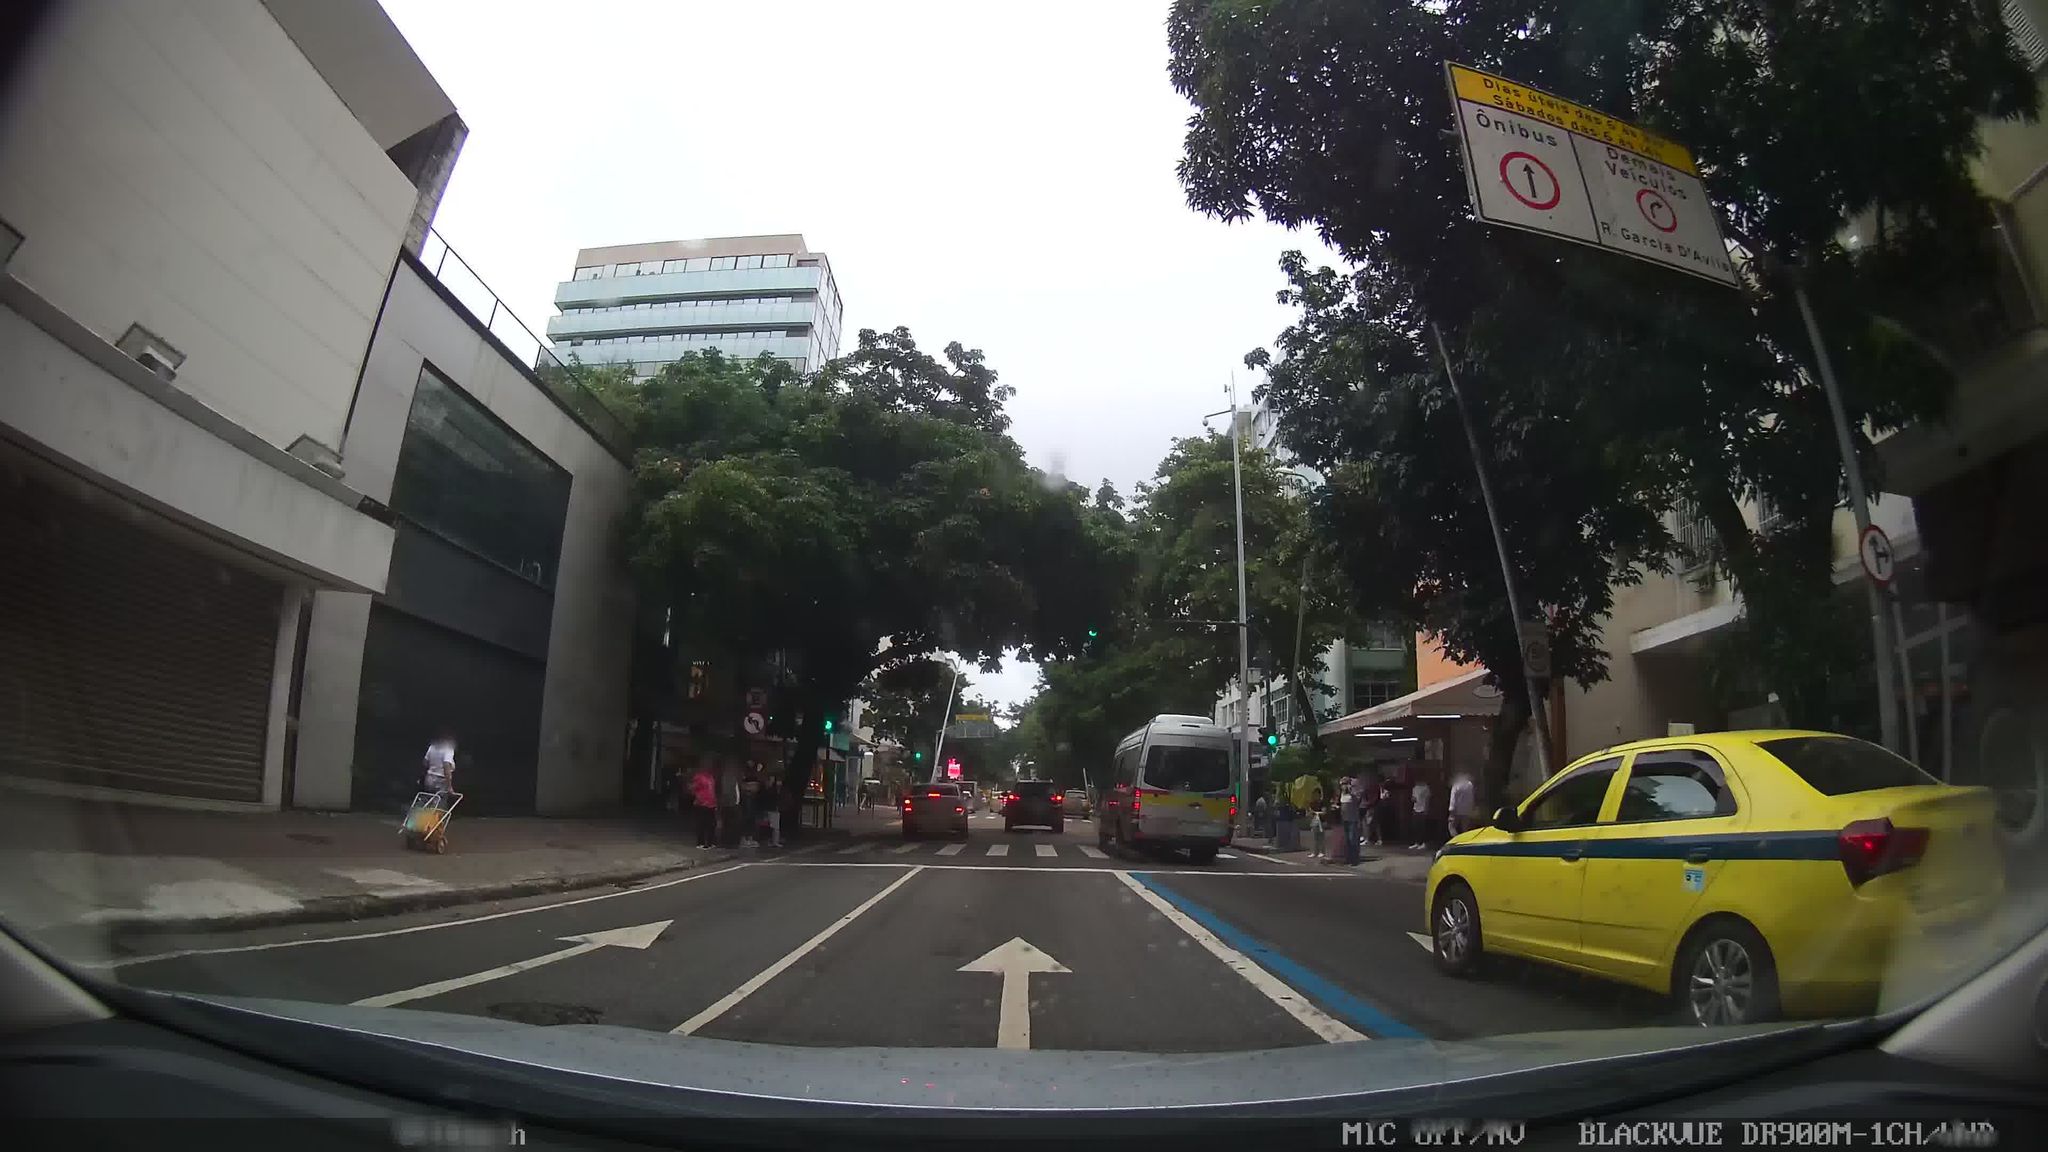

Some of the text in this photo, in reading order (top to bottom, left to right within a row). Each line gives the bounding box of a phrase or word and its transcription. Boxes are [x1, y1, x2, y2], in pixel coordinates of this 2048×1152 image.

[1483, 78, 1520, 97] Dias
[1493, 94, 1564, 125] Sábados
[1476, 109, 1557, 147] Ônibus
[1606, 147, 1676, 181] Demais
[1621, 228, 1673, 253] Garcia
